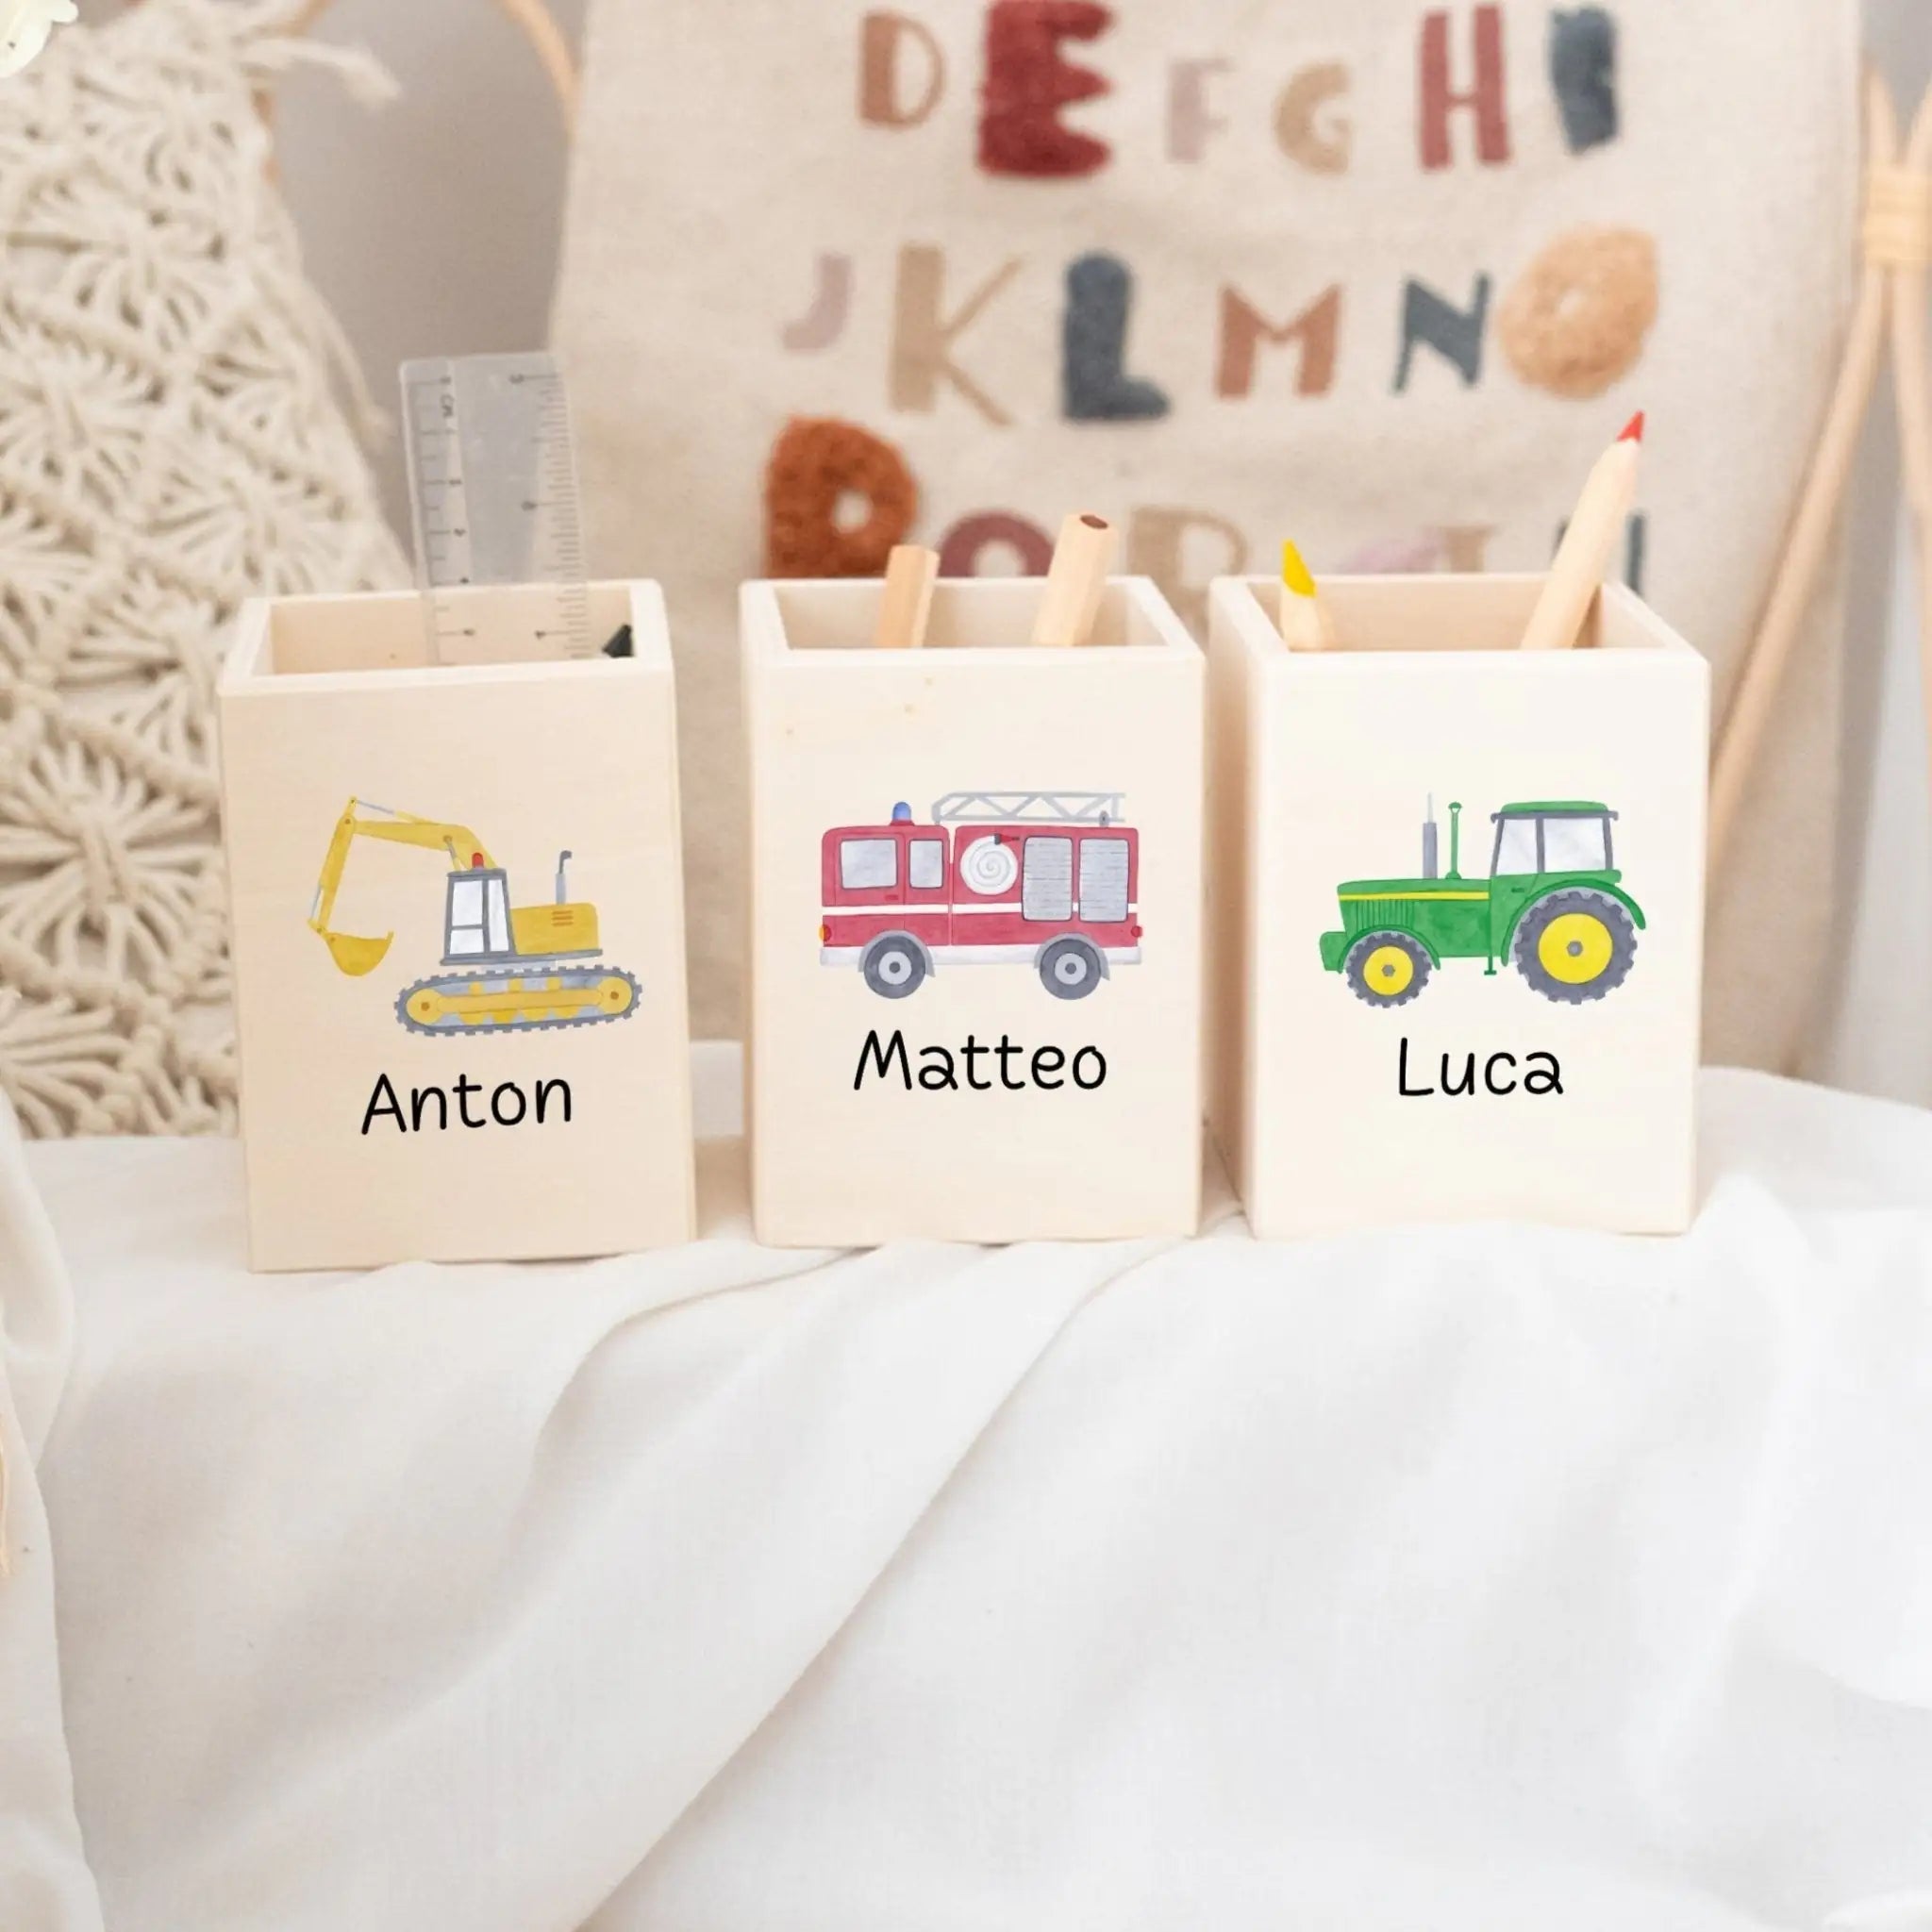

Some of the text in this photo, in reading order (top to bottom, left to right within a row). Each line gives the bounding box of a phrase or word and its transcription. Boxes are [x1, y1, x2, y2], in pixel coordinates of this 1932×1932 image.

[857, 11, 944, 131] D
[974, 0, 1114, 179] E
[1165, 57, 1231, 164] F
[1271, 61, 1352, 175] G
[1418, 3, 1512, 172] H
[780, 252, 856, 354] J
[887, 242, 1023, 428] K
[1059, 252, 1171, 425] L
[1213, 283, 1341, 400] M
[1393, 271, 1491, 394] N
[853, 1029, 1108, 1091] Matteo
[1398, 1037, 1564, 1098] Luca
[360, 1072, 574, 1137] Anton
